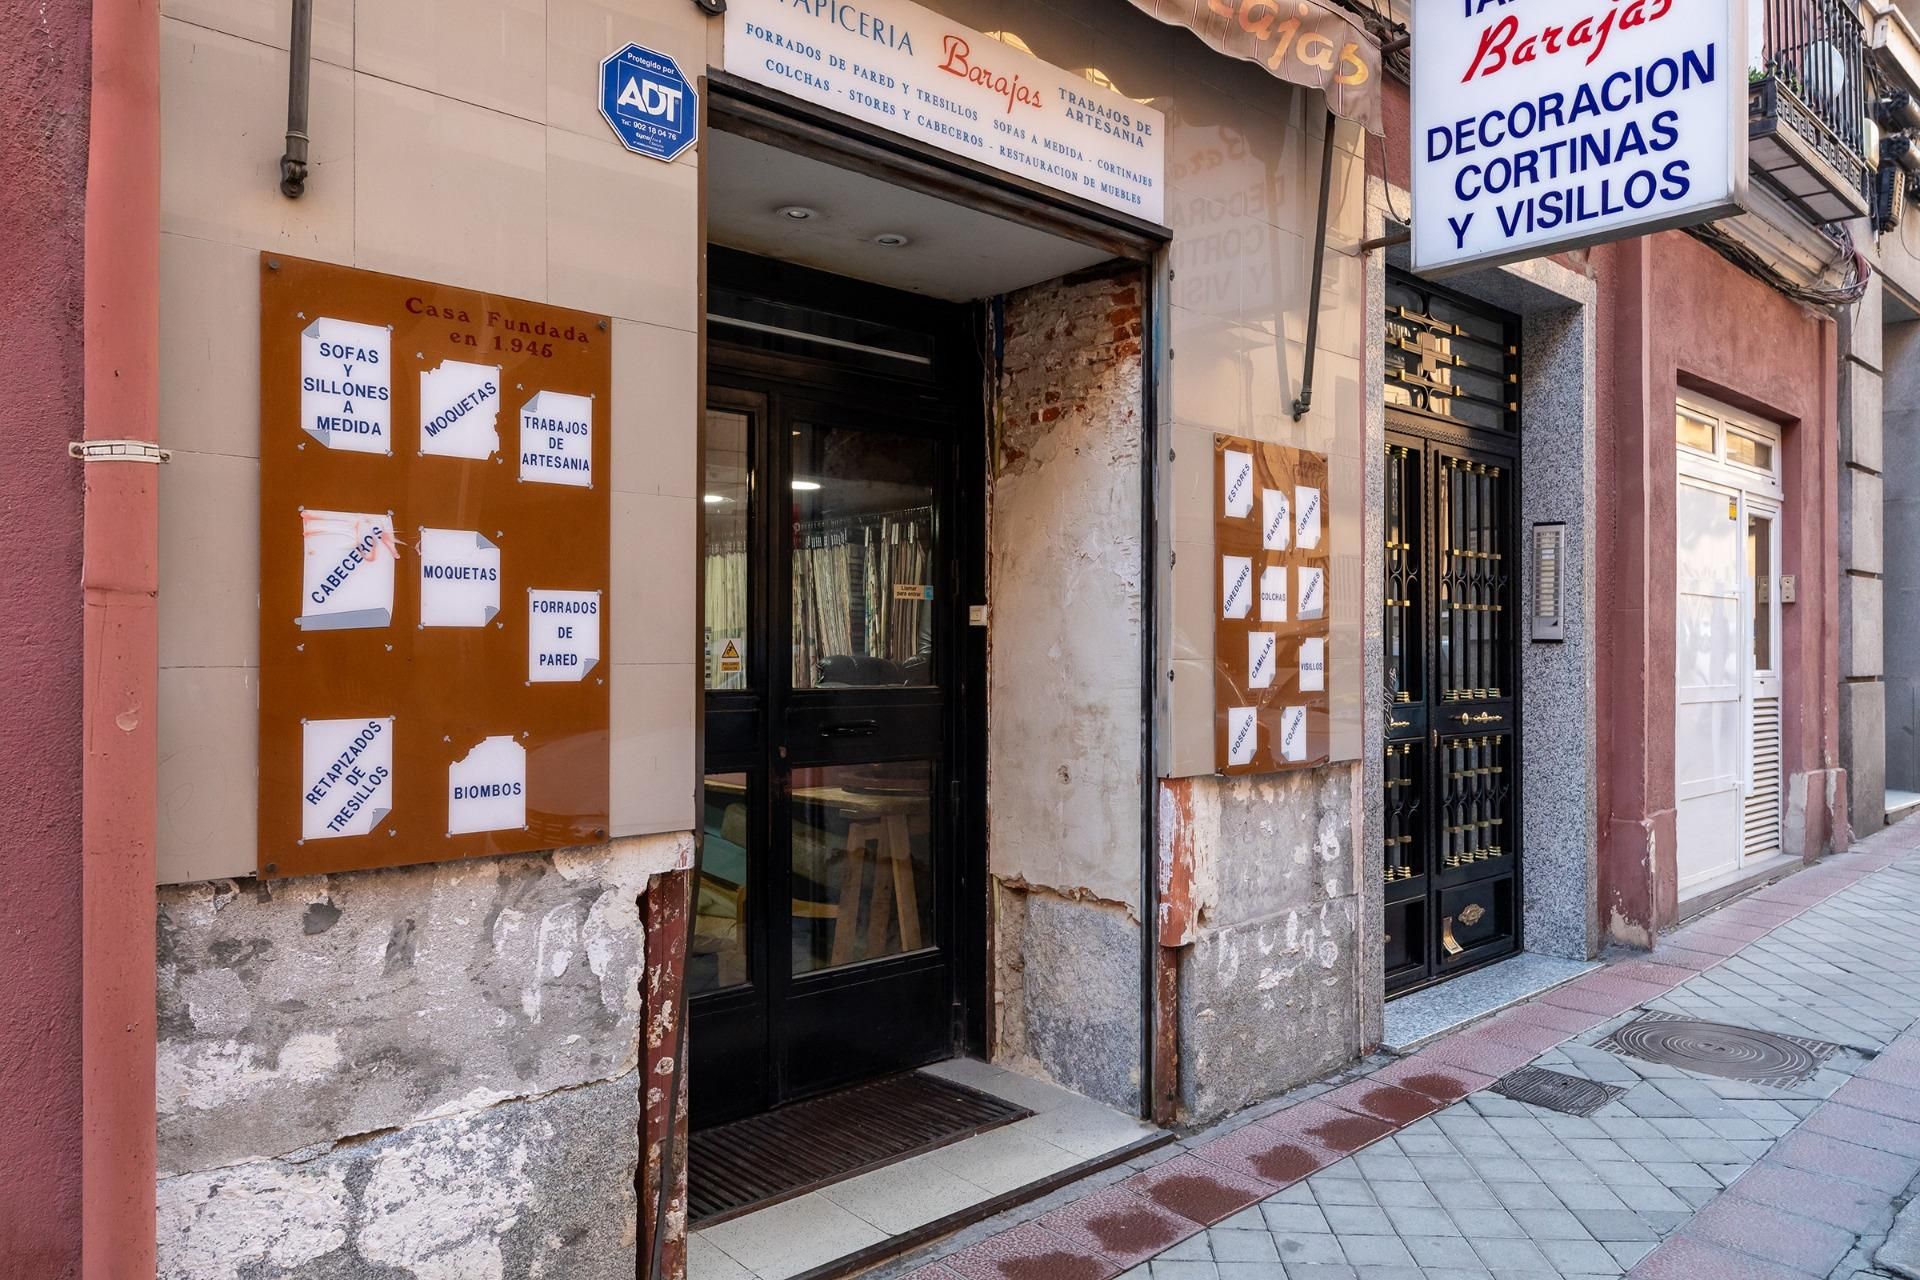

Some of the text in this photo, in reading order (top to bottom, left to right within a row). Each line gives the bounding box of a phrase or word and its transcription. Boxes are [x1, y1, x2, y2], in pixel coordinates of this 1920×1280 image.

[627, 52, 675, 75] Protegido por
[937, 34, 1043, 114] Barajas
[617, 76, 682, 122] ADT
[745, 22, 822, 61] FORRADOS
[829, 55, 846, 71] DE
[853, 64, 895, 89] PARED
[902, 83, 910, 95] Y
[917, 88, 978, 121] TRESILLOS
[993, 119, 1026, 140] SOFAS
[1031, 134, 1038, 145] A
[1044, 137, 1083, 162] MEDIDA
[1097, 159, 1153, 187] CORTINAJES
[1058, 87, 1152, 136] TRABAJOS DE
[1427, 43, 1716, 162] DECORACION
[766, 59, 830, 92] COLCHAS
[849, 89, 896, 116] STORES
[903, 109, 911, 121] Y
[917, 115, 984, 148] CABECEROS
[999, 145, 1078, 182] RESTAURACION
[1083, 175, 1096, 188] DE
[1100, 182, 1142, 205] MUEBLES
[1065, 107, 1144, 148] ARTESANIA
[1455, 110, 1679, 201] CORTINAS
[1448, 160, 1691, 249] Y VISILLOS
[405, 297, 590, 344] Casa Fundada
[450, 330, 478, 347] en
[319, 341, 379, 364] SOFAS
[343, 364, 353, 378] Y
[303, 377, 389, 401] SILLONES
[343, 400, 354, 414] A
[316, 415, 382, 436] MEDIDA
[424, 381, 498, 438] MOQUETAS
[524, 415, 588, 436] TRABAJOS
[521, 453, 590, 472] ARTESANIA
[549, 437, 564, 451] DE
[1227, 463, 1251, 504] ESTORES
[1266, 506, 1286, 542] BANDOS
[1297, 494, 1319, 536] CORTINAS
[311, 526, 383, 605] CABECEROS
[423, 565, 497, 581] MOQUETAS
[532, 600, 597, 615] FORRADOS
[1224, 565, 1251, 613] EDREDONES
[1261, 592, 1286, 602] COLCHAS
[1300, 571, 1321, 610] SOMIERES
[558, 626, 573, 639] DE
[539, 653, 578, 666] PARED
[1251, 636, 1274, 680] CAMILLAS
[1301, 661, 1323, 671] VISILLOS
[1232, 714, 1254, 755] DOSELES
[1285, 709, 1303, 747] COJINES
[305, 720, 382, 806] RETAPIZADOS
[345, 766, 367, 787] DE
[327, 765, 389, 834] TRESILLOS
[454, 782, 522, 800] BIOMBOS
